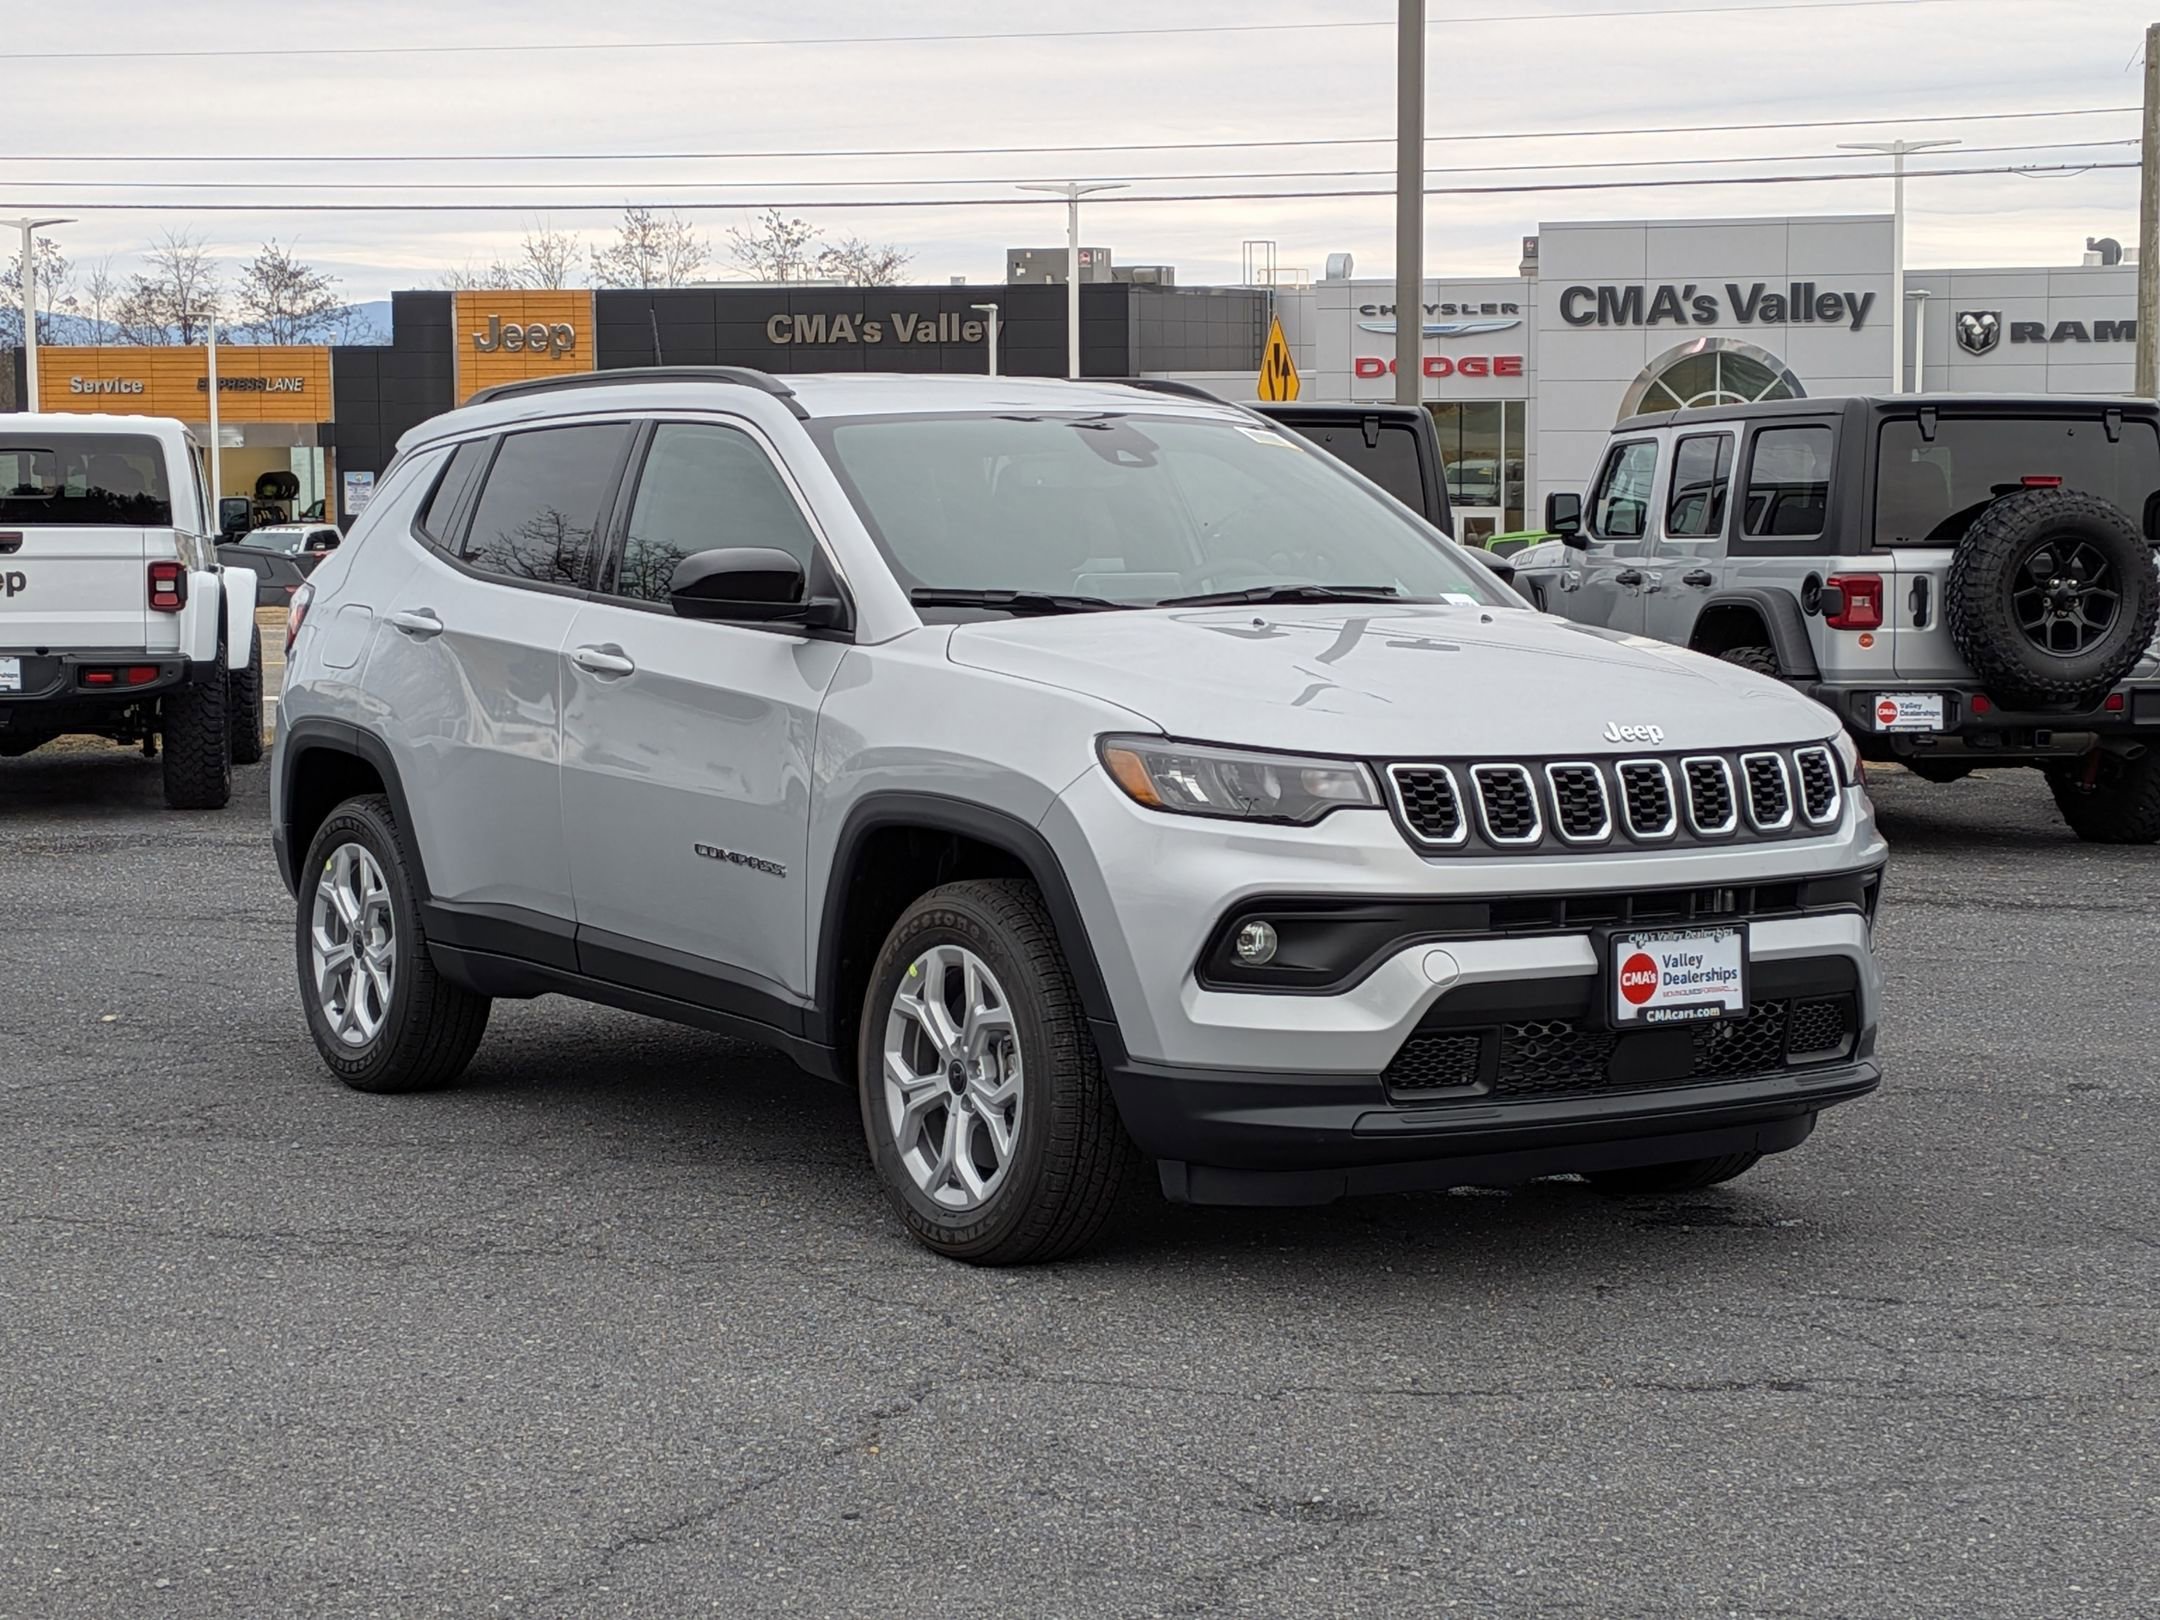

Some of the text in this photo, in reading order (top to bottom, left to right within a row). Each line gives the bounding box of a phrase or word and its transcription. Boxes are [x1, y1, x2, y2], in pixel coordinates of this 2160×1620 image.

[1359, 303, 1519, 316] CHYSLER
[1560, 282, 1877, 331] CMA's Valley
[472, 314, 575, 359] Jeep
[767, 313, 882, 344] CMA's
[2010, 320, 2137, 343] RAM
[1355, 355, 1523, 378] DDGE
[70, 375, 145, 394] Service
[196, 377, 265, 392] EPRESS
[0, 571, 27, 597] p
[1603, 721, 1664, 745] Jeep
[1662, 953, 1704, 969] Valley
[1622, 970, 1657, 986] CMA's
[1662, 966, 1738, 987] Dealerships
[1646, 1007, 1720, 1022] CMAcars.com
